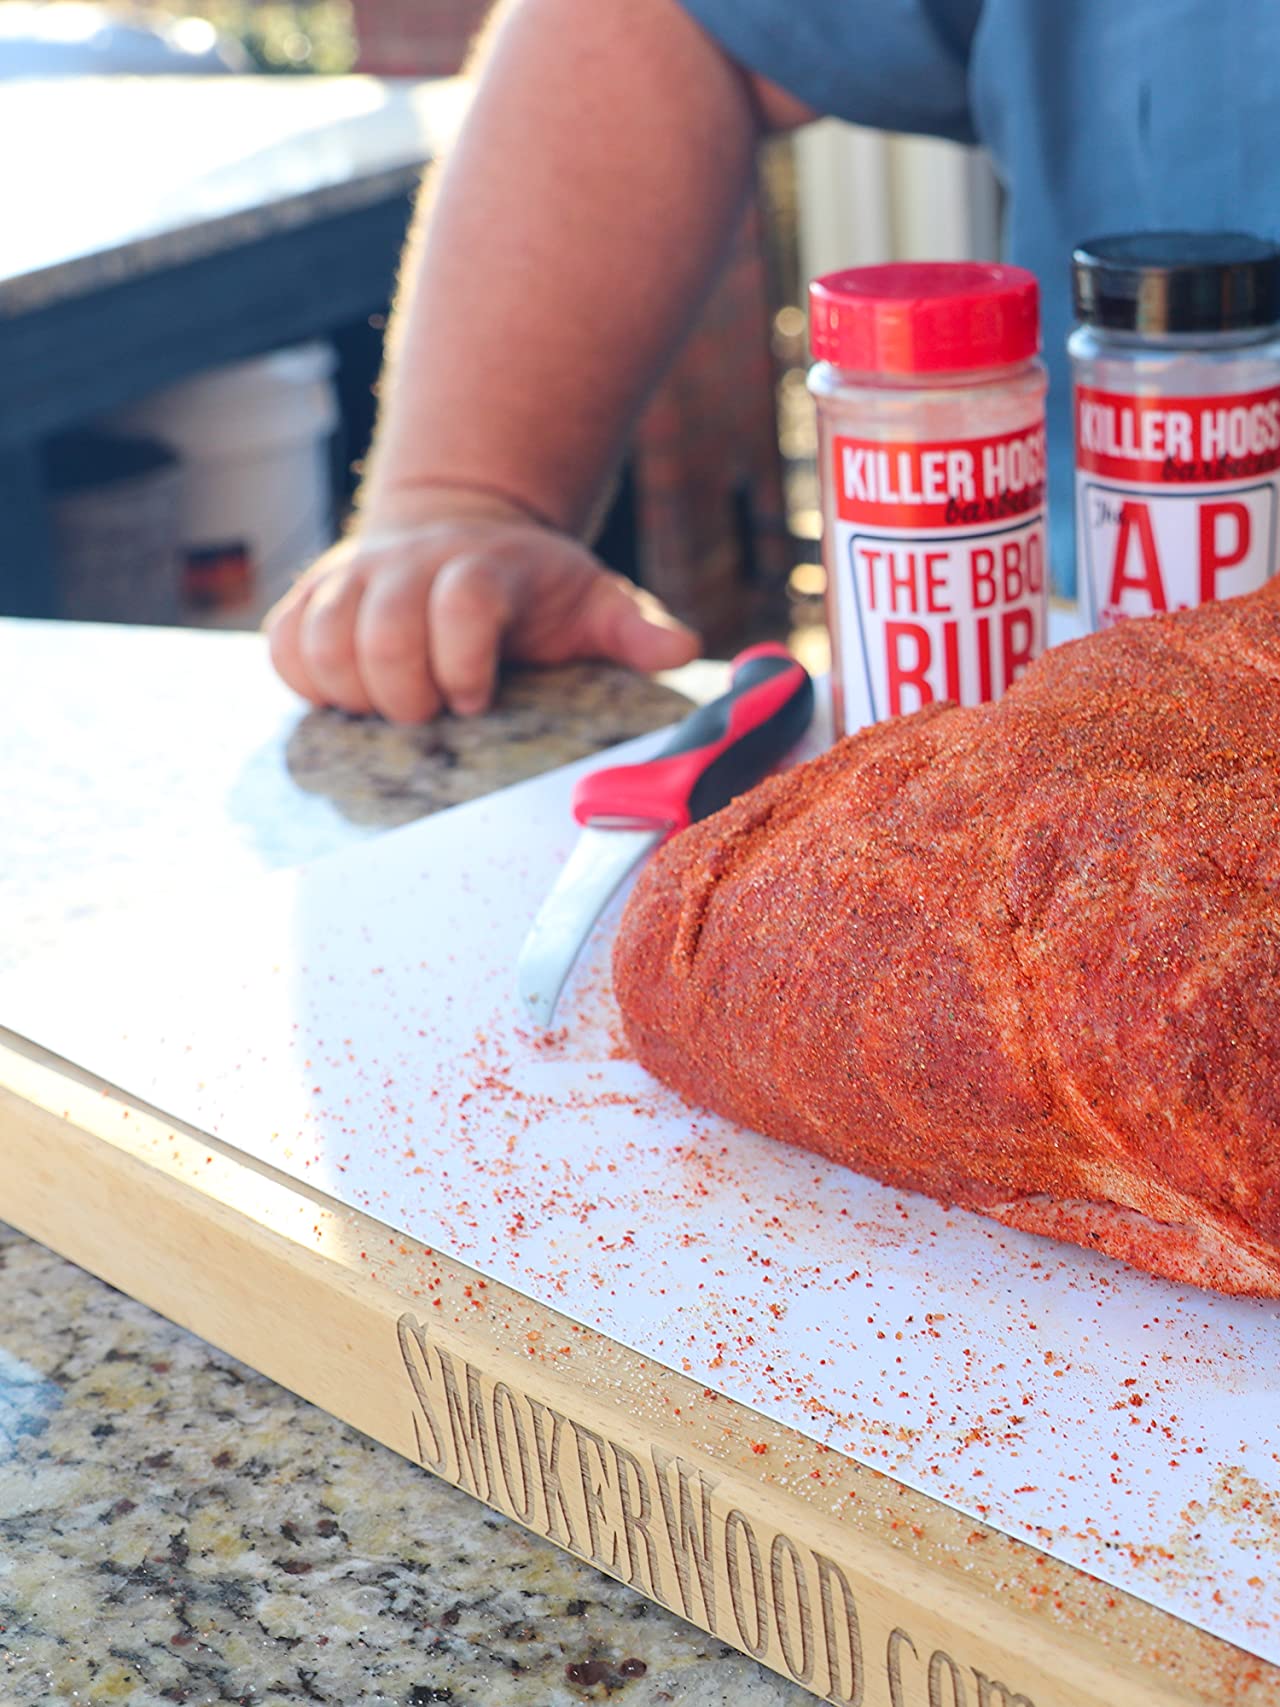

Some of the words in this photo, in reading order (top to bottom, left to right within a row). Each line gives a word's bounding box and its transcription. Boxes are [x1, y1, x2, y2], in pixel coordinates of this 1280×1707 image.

[1080, 400, 1193, 462] KILLER
[842, 446, 974, 505] KILLER
[860, 550, 951, 614] THE
